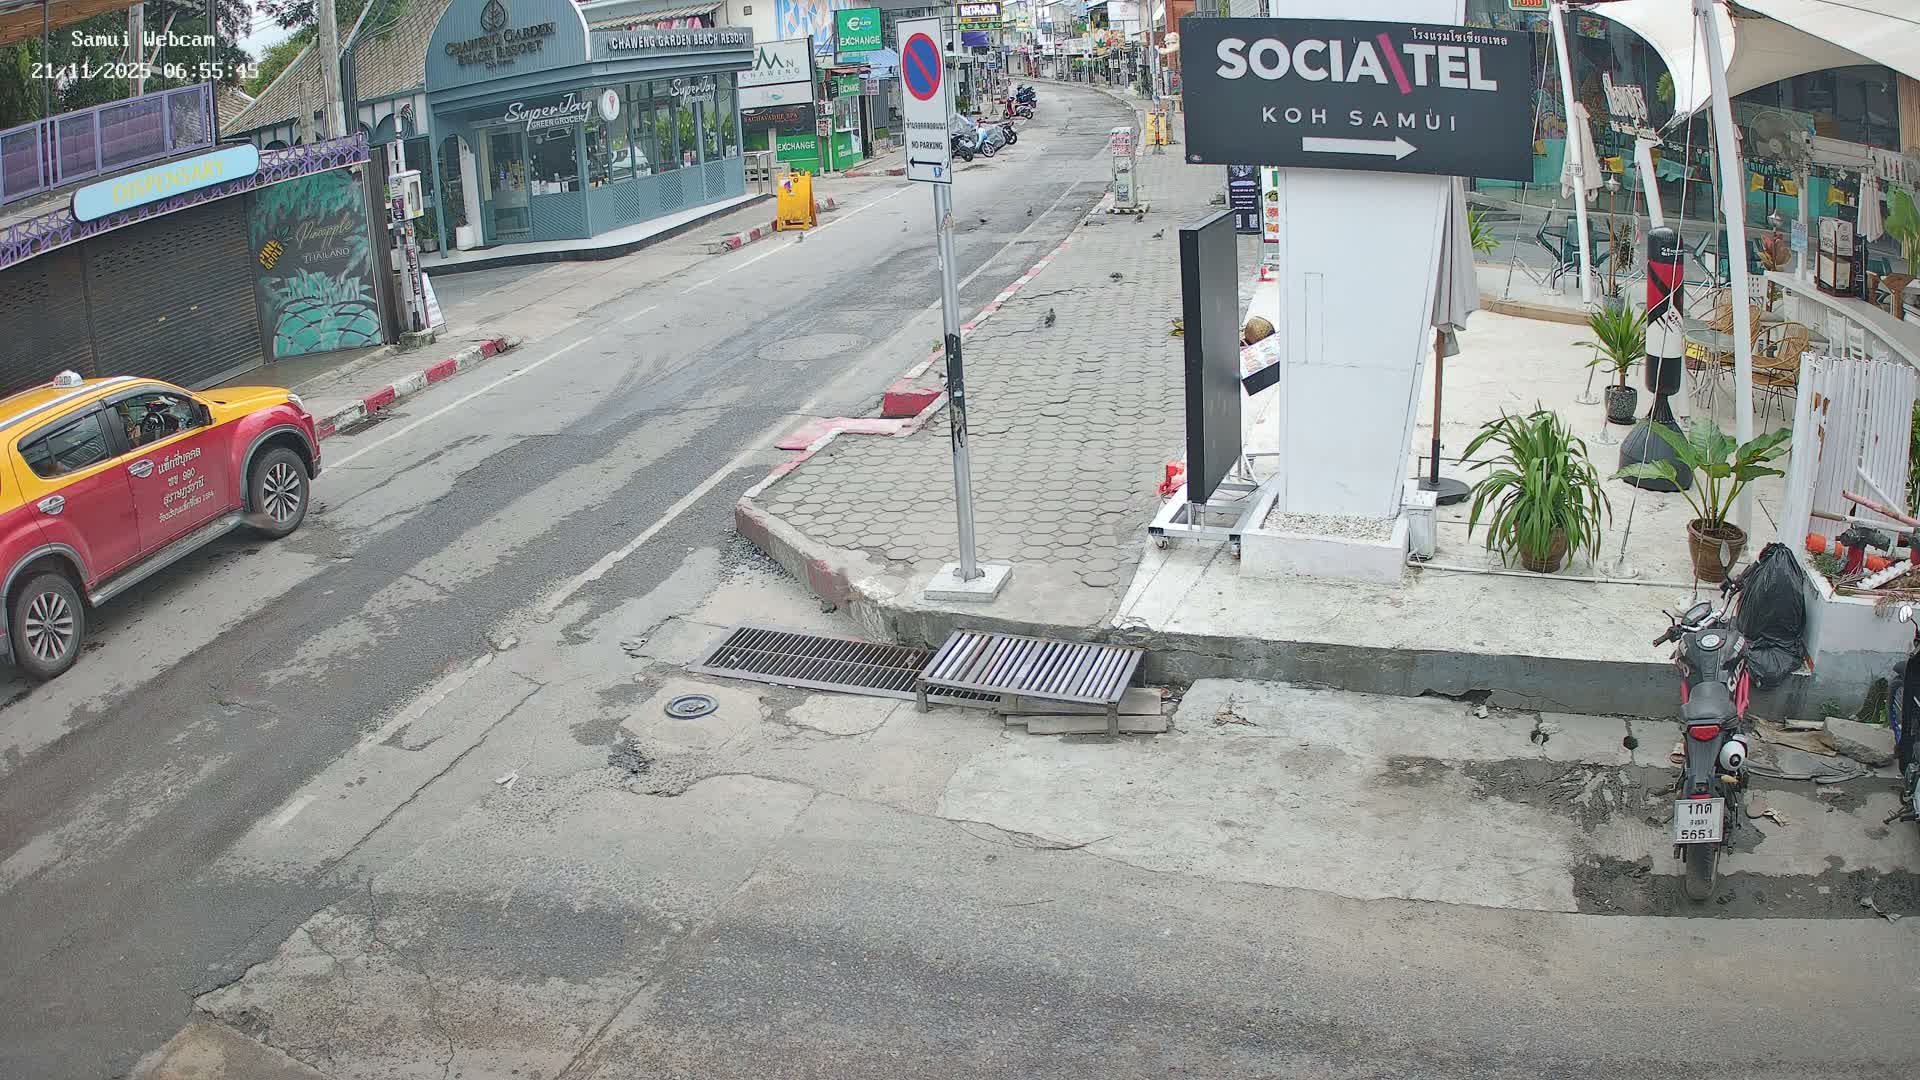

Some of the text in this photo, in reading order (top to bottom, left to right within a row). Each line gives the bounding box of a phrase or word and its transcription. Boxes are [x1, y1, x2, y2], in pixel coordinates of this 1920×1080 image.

[610, 32, 748, 50] CHAWENG GARDEN BEACH RESORT
[841, 36, 881, 46] EXCHANGE
[531, 119, 554, 130] GREEN
[1262, 106, 1456, 132] KOH SAMUI
[777, 141, 815, 151] EXCHANGE
[912, 140, 943, 150] NO PARKING
[113, 159, 225, 205] DISPENSARY
[304, 248, 350, 264] THAILAND
[1681, 829, 1713, 840] 5651
